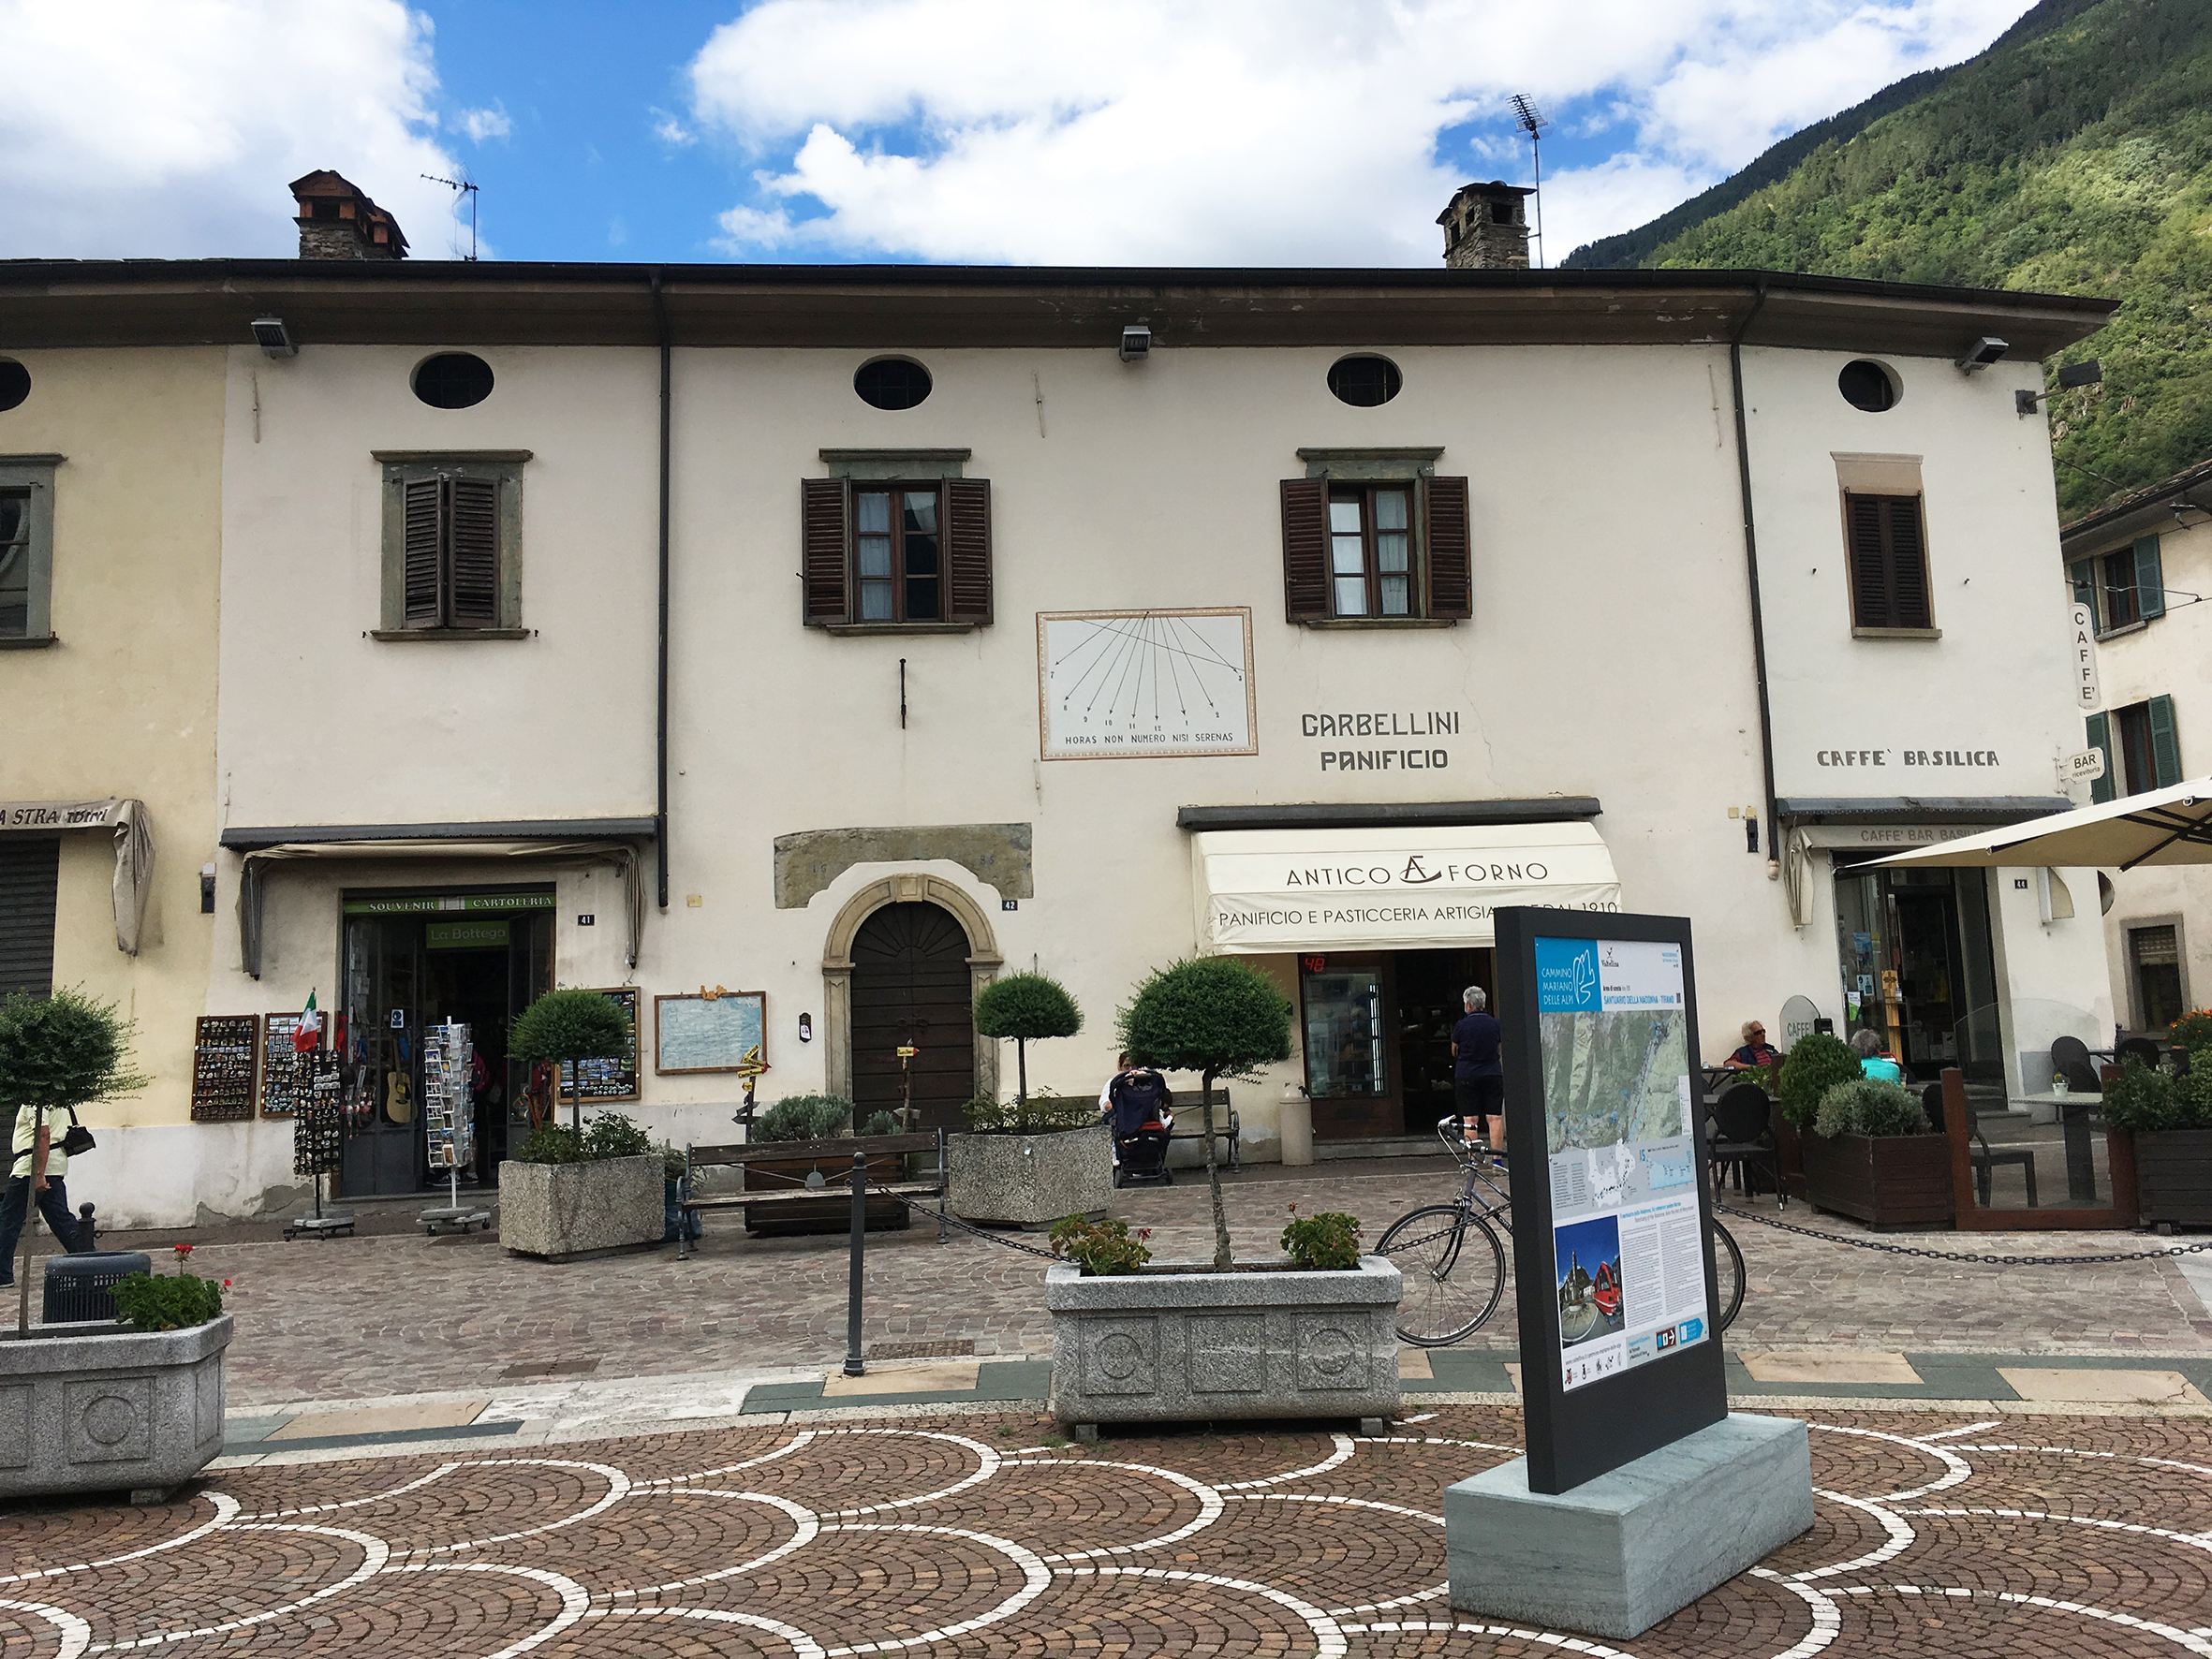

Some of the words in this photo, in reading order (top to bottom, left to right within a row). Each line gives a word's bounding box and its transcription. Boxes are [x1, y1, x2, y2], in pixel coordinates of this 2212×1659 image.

[2074, 612, 2095, 699] CAFFE'
[1302, 712, 1459, 737] GARBELLINI
[1065, 735, 1097, 744] HORAS
[1104, 734, 1124, 743] NON
[1130, 733, 1166, 743] NUMERO
[1172, 733, 1189, 742] NISI
[1195, 732, 1233, 742] SERENAS
[1320, 749, 1448, 771] PANIFICIO
[1904, 750, 1999, 766] BASILICA
[2073, 754, 2097, 769] BAR
[2072, 766, 2101, 779] ricevitoria
[1861, 830, 1903, 842] CAFFE'
[1908, 830, 1933, 842] BAR
[1287, 866, 1391, 886] ANTICO
[1448, 862, 1548, 882] FORNO
[369, 901, 435, 911] SOUVENIR
[473, 896, 553, 908] CARTOLERIA
[1005, 901, 1015, 909] 42
[581, 916, 591, 925] 41
[1219, 910, 1302, 926] PANIFICIO
[1308, 910, 1318, 924] E
[1324, 907, 1429, 923] PASTICCERIA
[431, 929, 448, 941] La
[452, 927, 506, 941] Bottega
[1305, 957, 1325, 973] 48
[1541, 968, 1572, 978] CAMMINO
[1542, 981, 1573, 991] MARIANO
[1543, 994, 1560, 1005] DELLE
[1561, 994, 1573, 1005] ALPI
